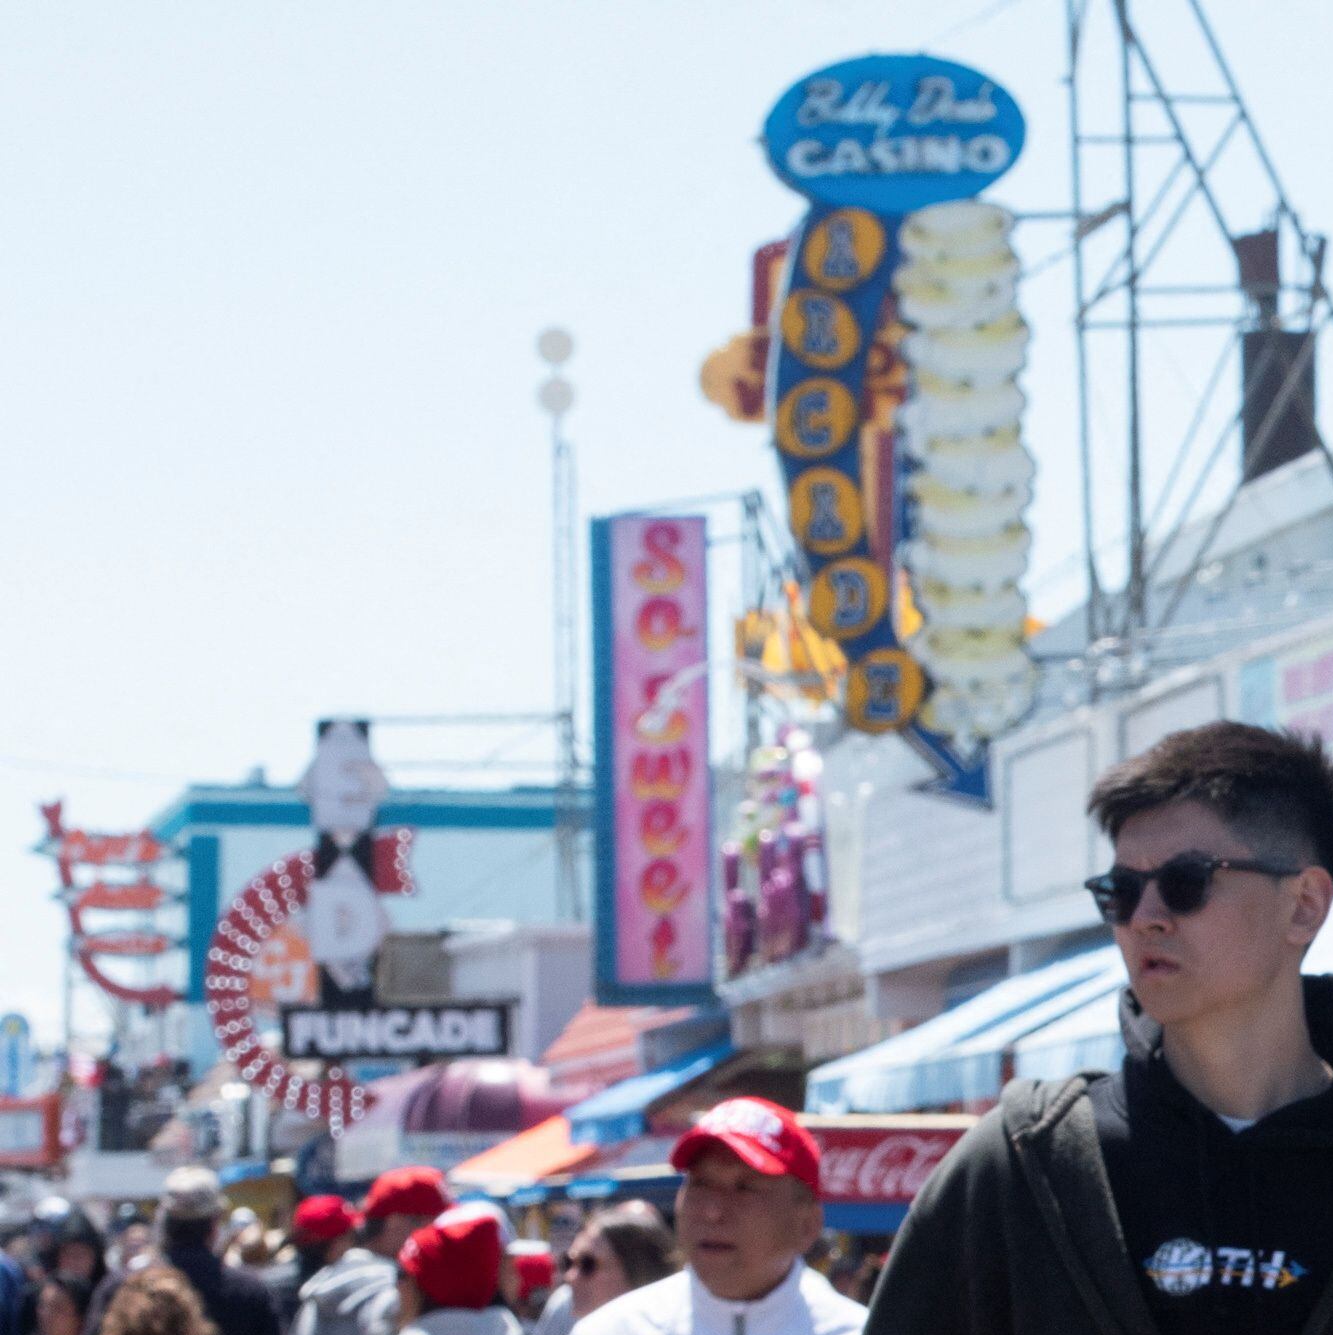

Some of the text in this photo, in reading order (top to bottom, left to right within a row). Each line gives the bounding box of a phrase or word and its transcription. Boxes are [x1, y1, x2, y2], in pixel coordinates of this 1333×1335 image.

[786, 135, 1010, 177] CASINO
[794, 214, 900, 722] ARCADE
[288, 1008, 500, 1053] FUNCADE
